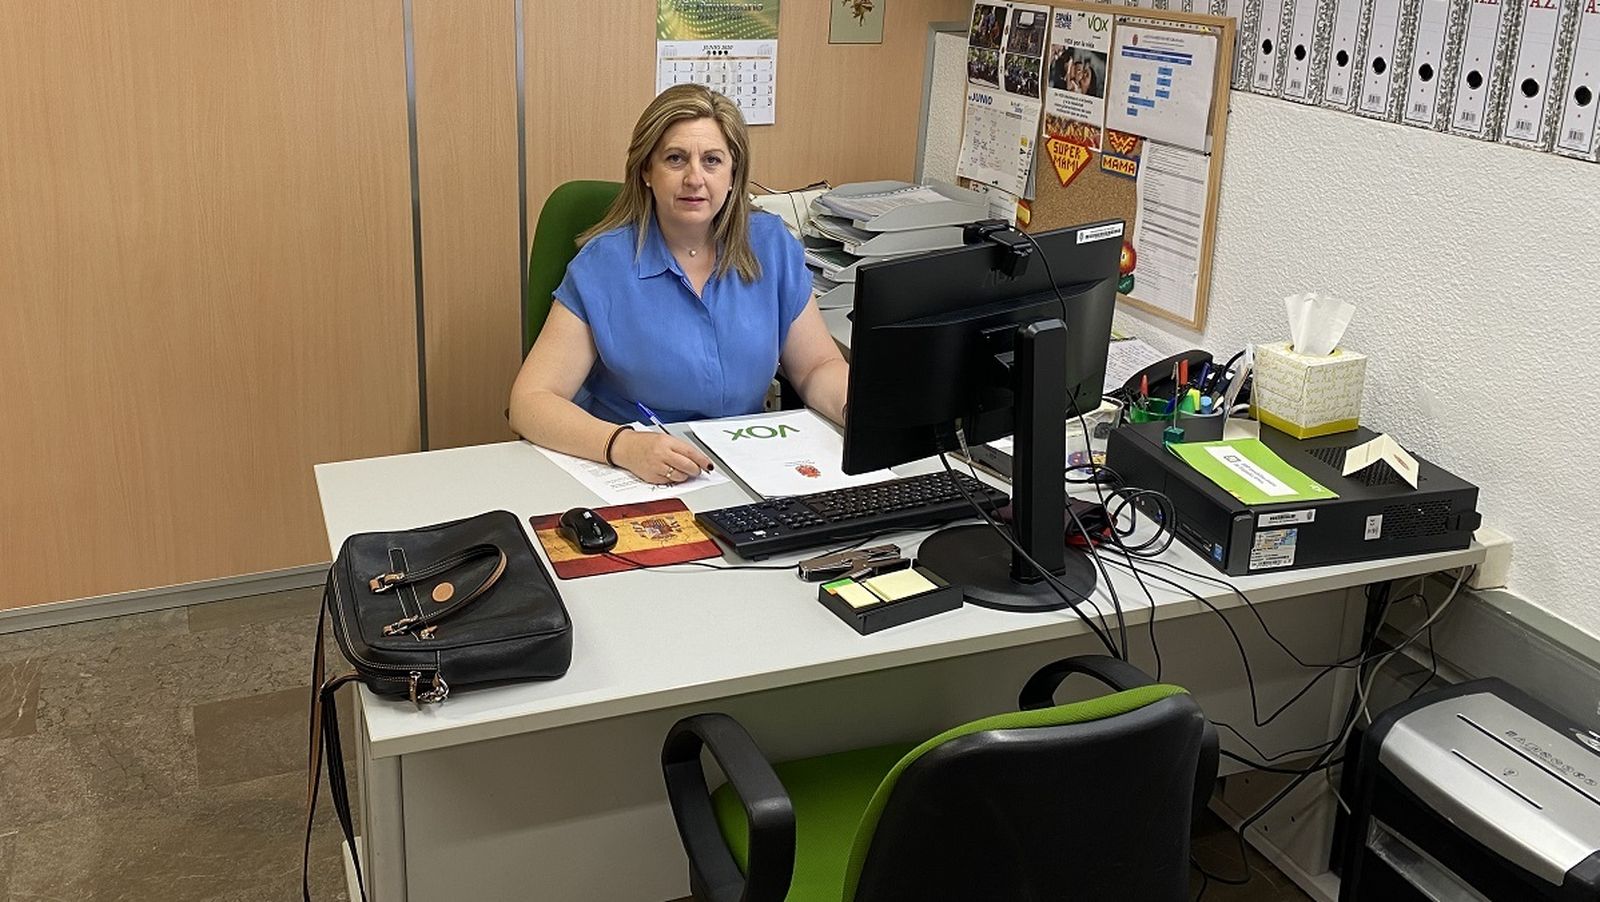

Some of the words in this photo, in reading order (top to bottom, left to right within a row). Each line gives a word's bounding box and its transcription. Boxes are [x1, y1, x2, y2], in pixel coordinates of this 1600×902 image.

[1088, 14, 1109, 32] VOX
[971, 92, 993, 105] JUNIO
[1053, 141, 1081, 160] SUPER
[1054, 154, 1080, 171] MAMI
[1103, 156, 1136, 174] MAMA
[723, 424, 800, 441] VOX
